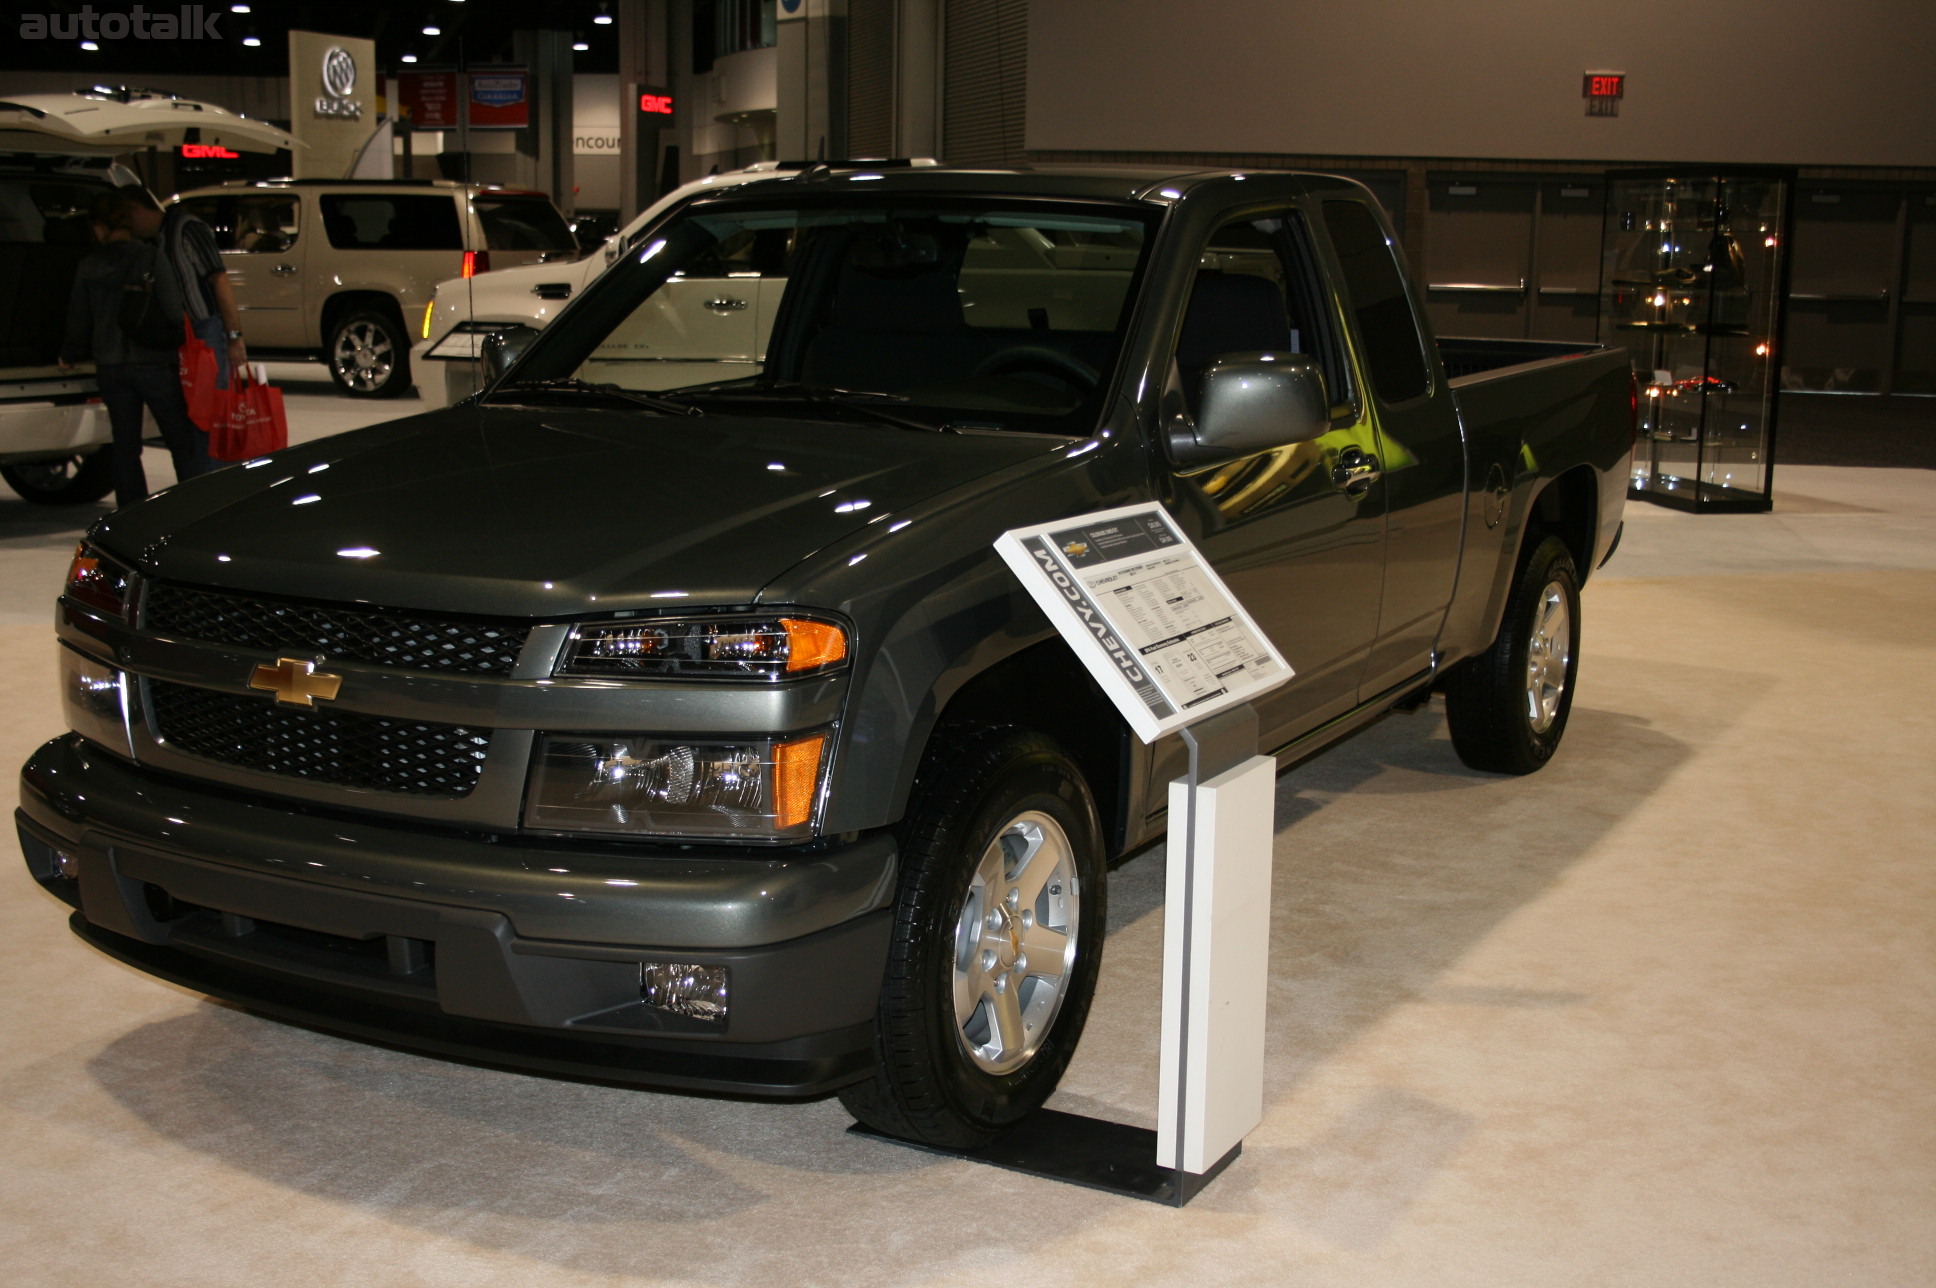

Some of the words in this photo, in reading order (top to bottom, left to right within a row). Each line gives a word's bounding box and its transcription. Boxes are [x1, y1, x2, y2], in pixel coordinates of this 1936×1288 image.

[1592, 76, 1619, 95] EXIT
[641, 94, 672, 114] GMC
[573, 136, 620, 149] ncour
[1033, 549, 1143, 682] CHEVY.COM
[1187, 652, 1197, 662] 23
[1154, 665, 1164, 674] 17
